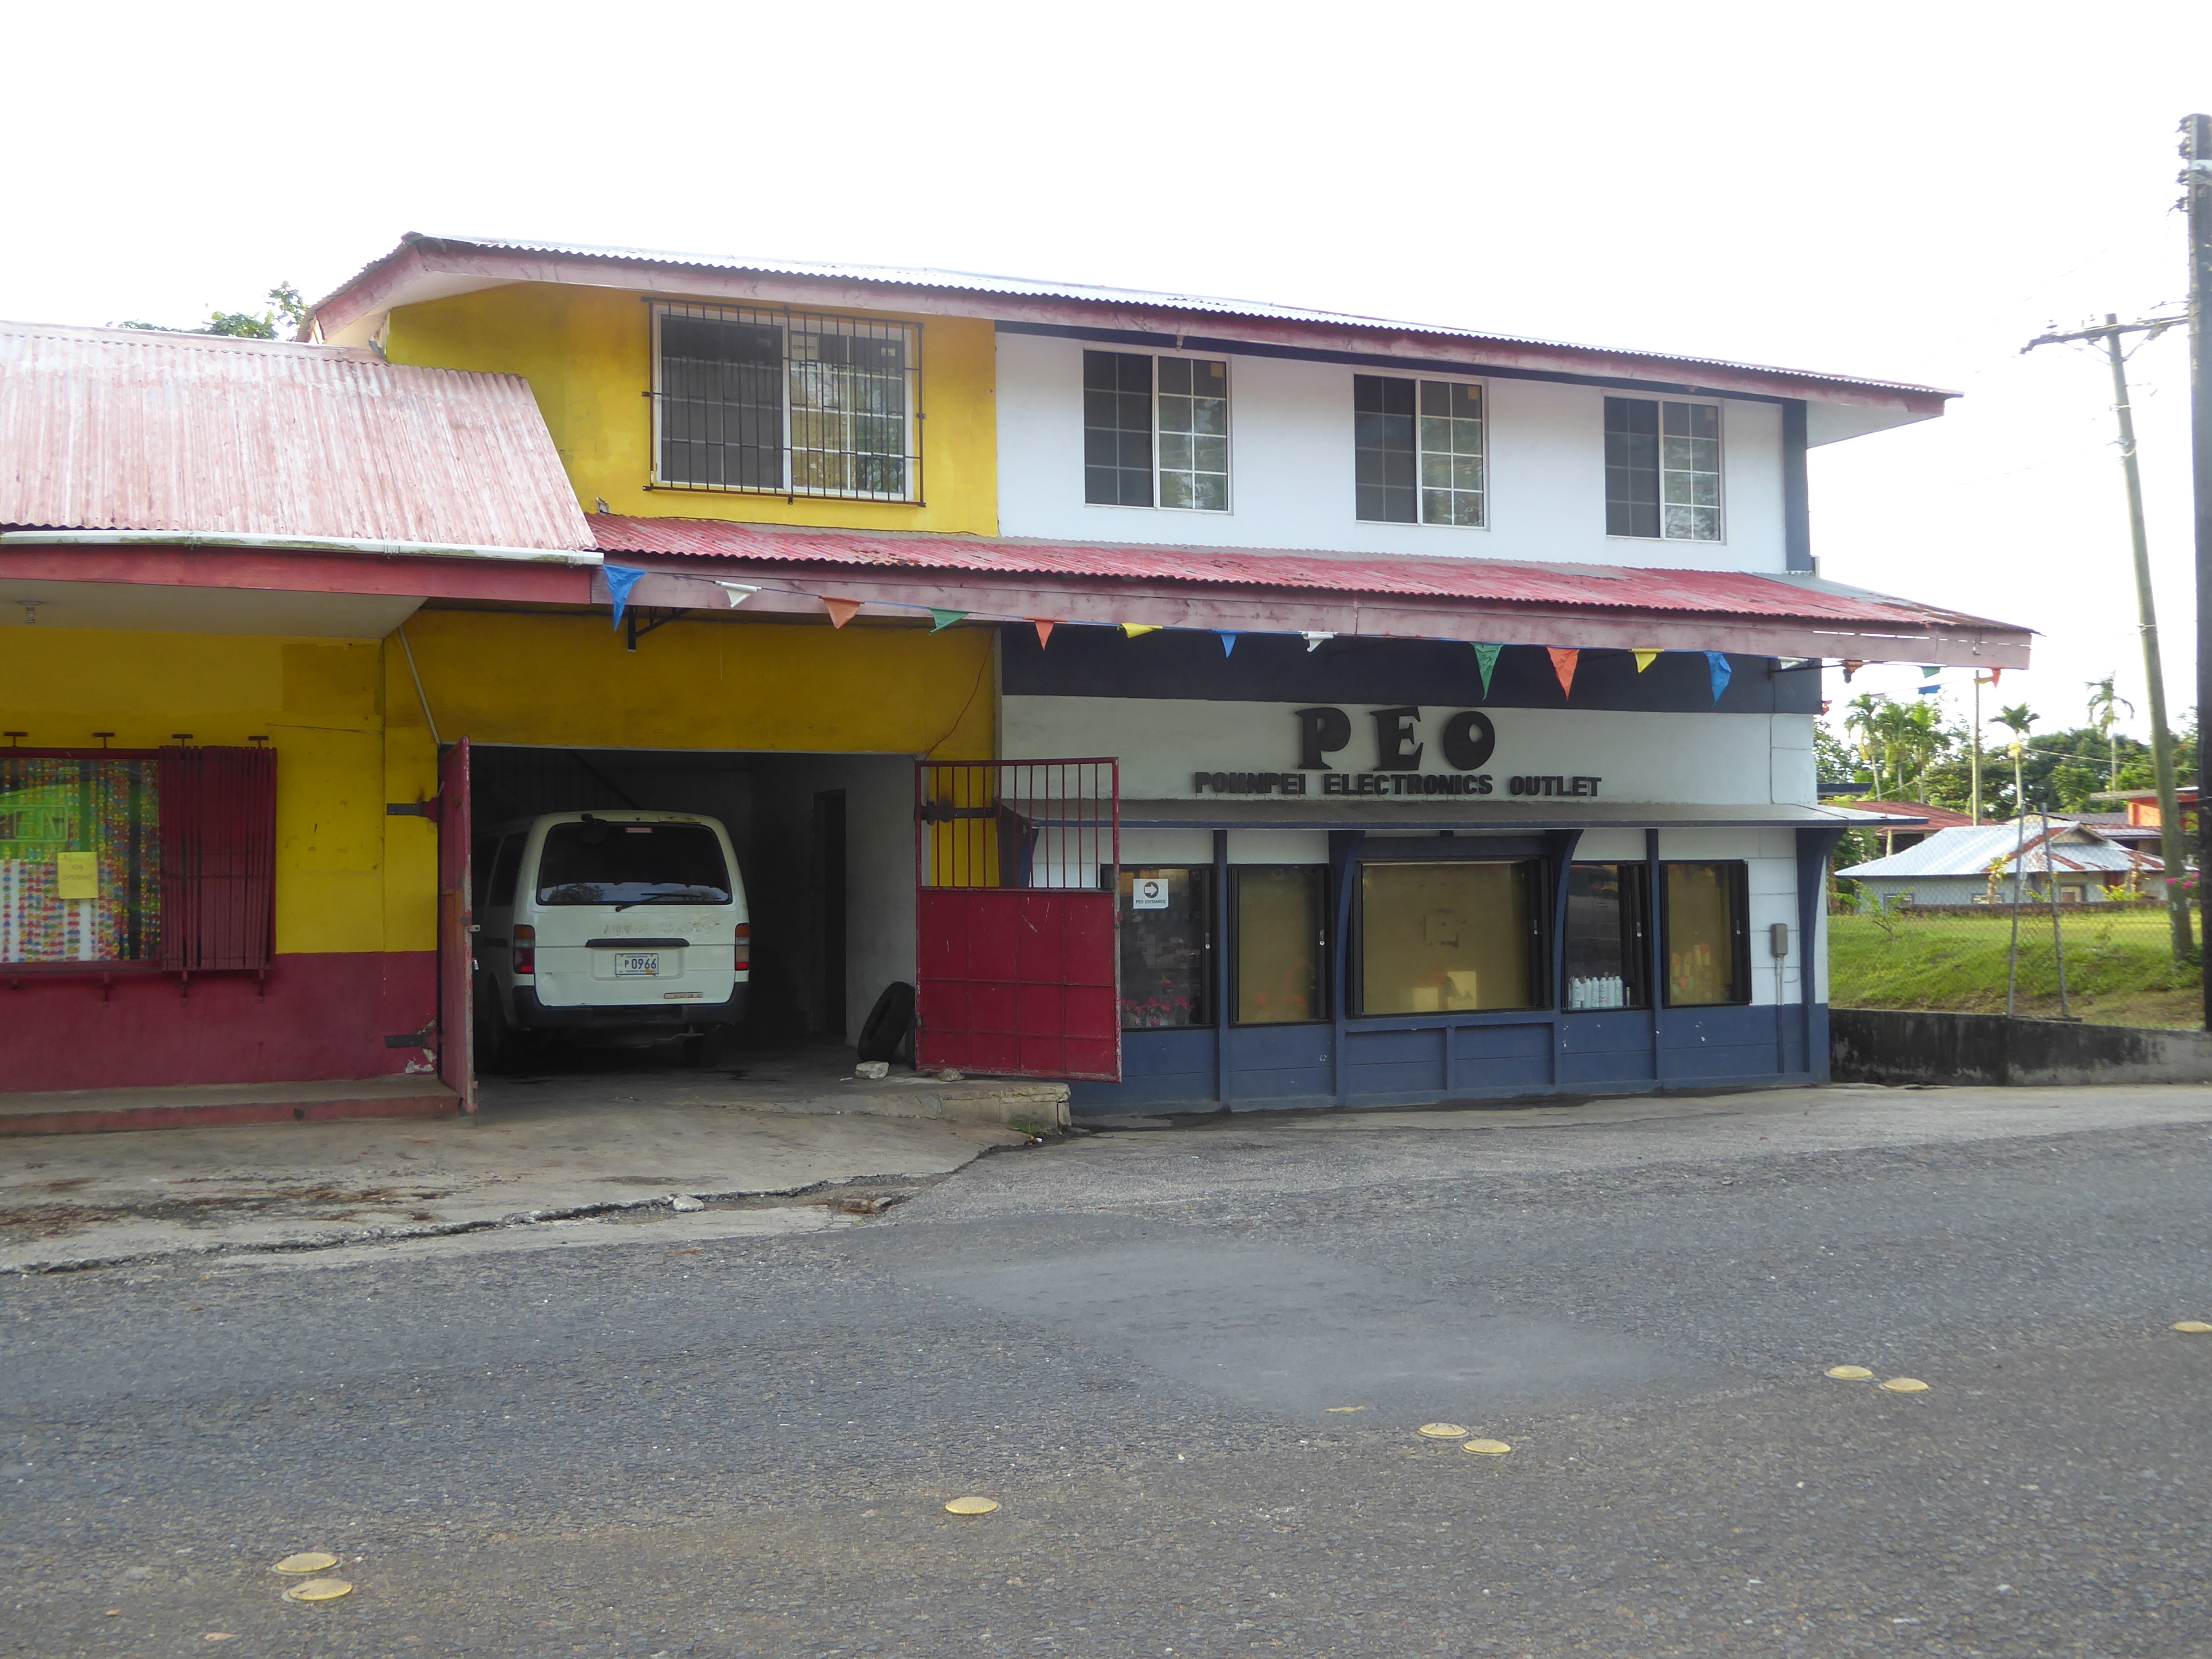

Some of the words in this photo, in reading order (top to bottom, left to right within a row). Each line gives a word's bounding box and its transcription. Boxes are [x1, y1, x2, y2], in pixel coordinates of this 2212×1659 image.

[1295, 706, 1495, 771] PEO
[1195, 772, 1306, 794] POHNPEI
[1324, 774, 1493, 795] ELECTRONICS
[1510, 776, 1602, 796] OUTLET
[624, 959, 629, 968] P
[632, 958, 656, 969] 0966
